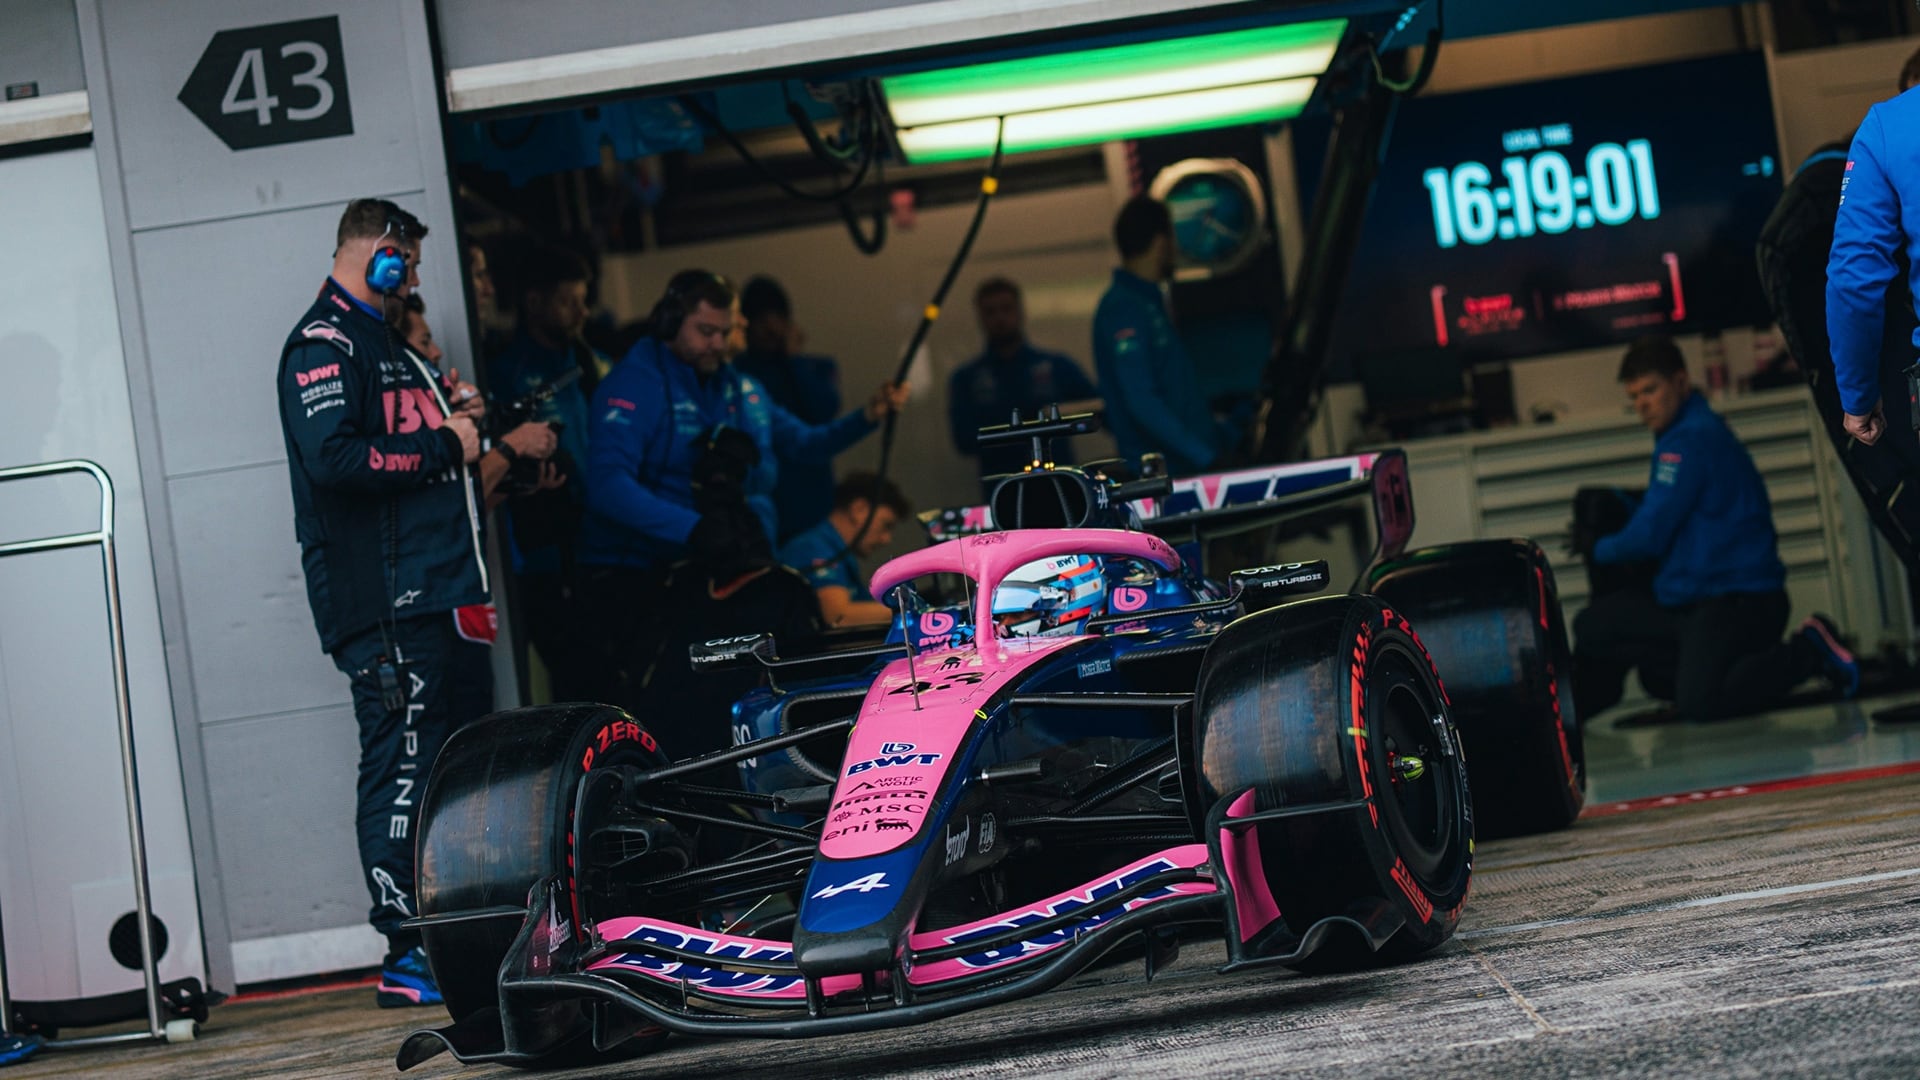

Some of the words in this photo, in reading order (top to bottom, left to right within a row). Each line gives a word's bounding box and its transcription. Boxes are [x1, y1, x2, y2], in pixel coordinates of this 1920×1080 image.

[221, 41, 335, 126] 43
[1423, 138, 1660, 248] 16:19:01
[301, 380, 343, 399] MOBILIZE
[384, 453, 421, 472] BWT
[1056, 556, 1077, 568] BWT
[1382, 609, 1394, 629] P
[596, 720, 657, 753] ZERO
[389, 672, 426, 839] ALPINE
[846, 754, 942, 778] BWT
[874, 776, 924, 784] ARCTIC
[859, 803, 924, 816] MSC
[824, 820, 869, 841] eni
